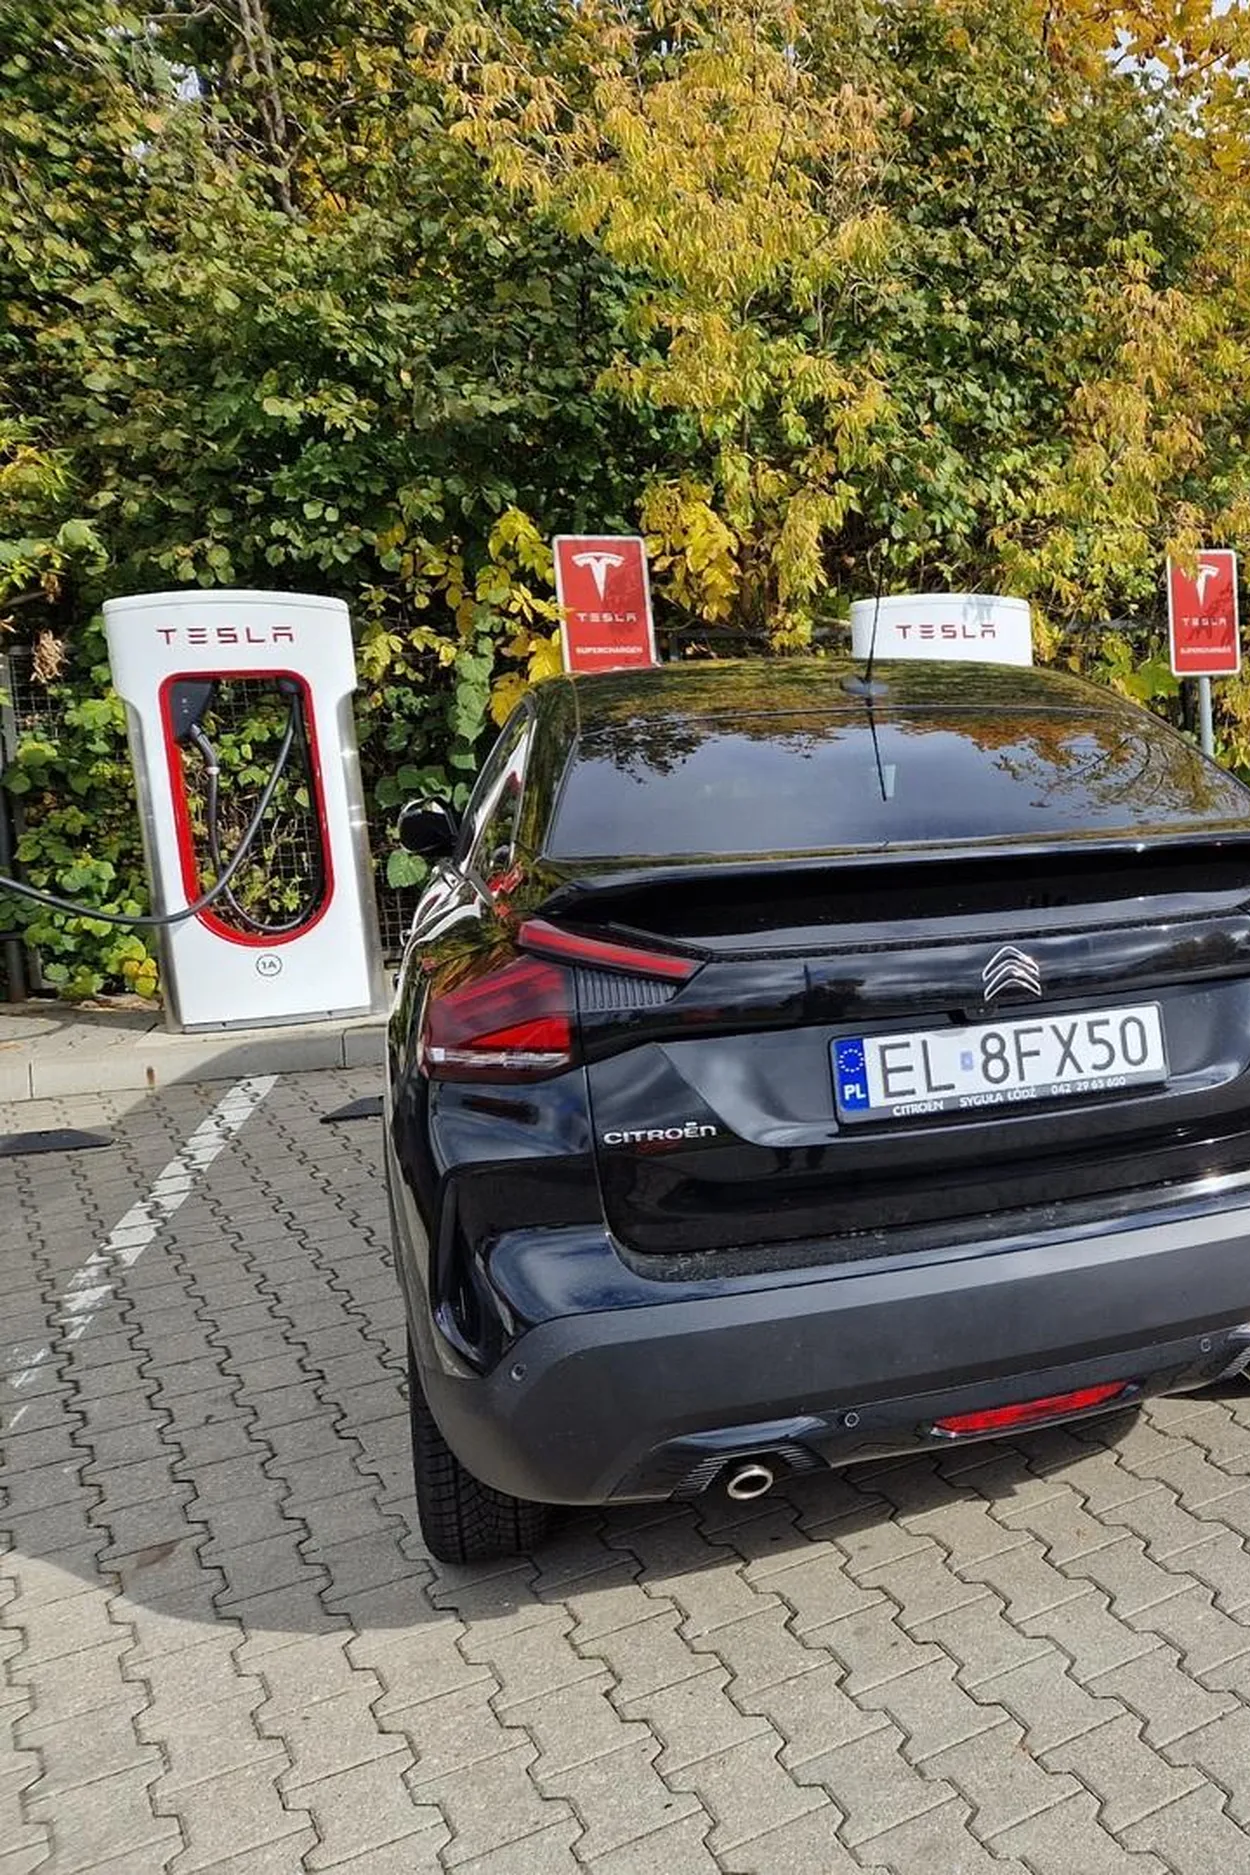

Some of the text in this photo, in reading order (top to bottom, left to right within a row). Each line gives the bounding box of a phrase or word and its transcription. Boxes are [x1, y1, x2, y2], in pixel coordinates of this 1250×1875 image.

[576, 612, 638, 623] TESLA
[1182, 617, 1227, 627] TESLA
[156, 626, 294, 645] TESLA
[895, 624, 996, 640] TESLA
[261, 960, 277, 970] 1A
[878, 1015, 1149, 1099] EL 8FX50
[843, 1083, 866, 1101] PL
